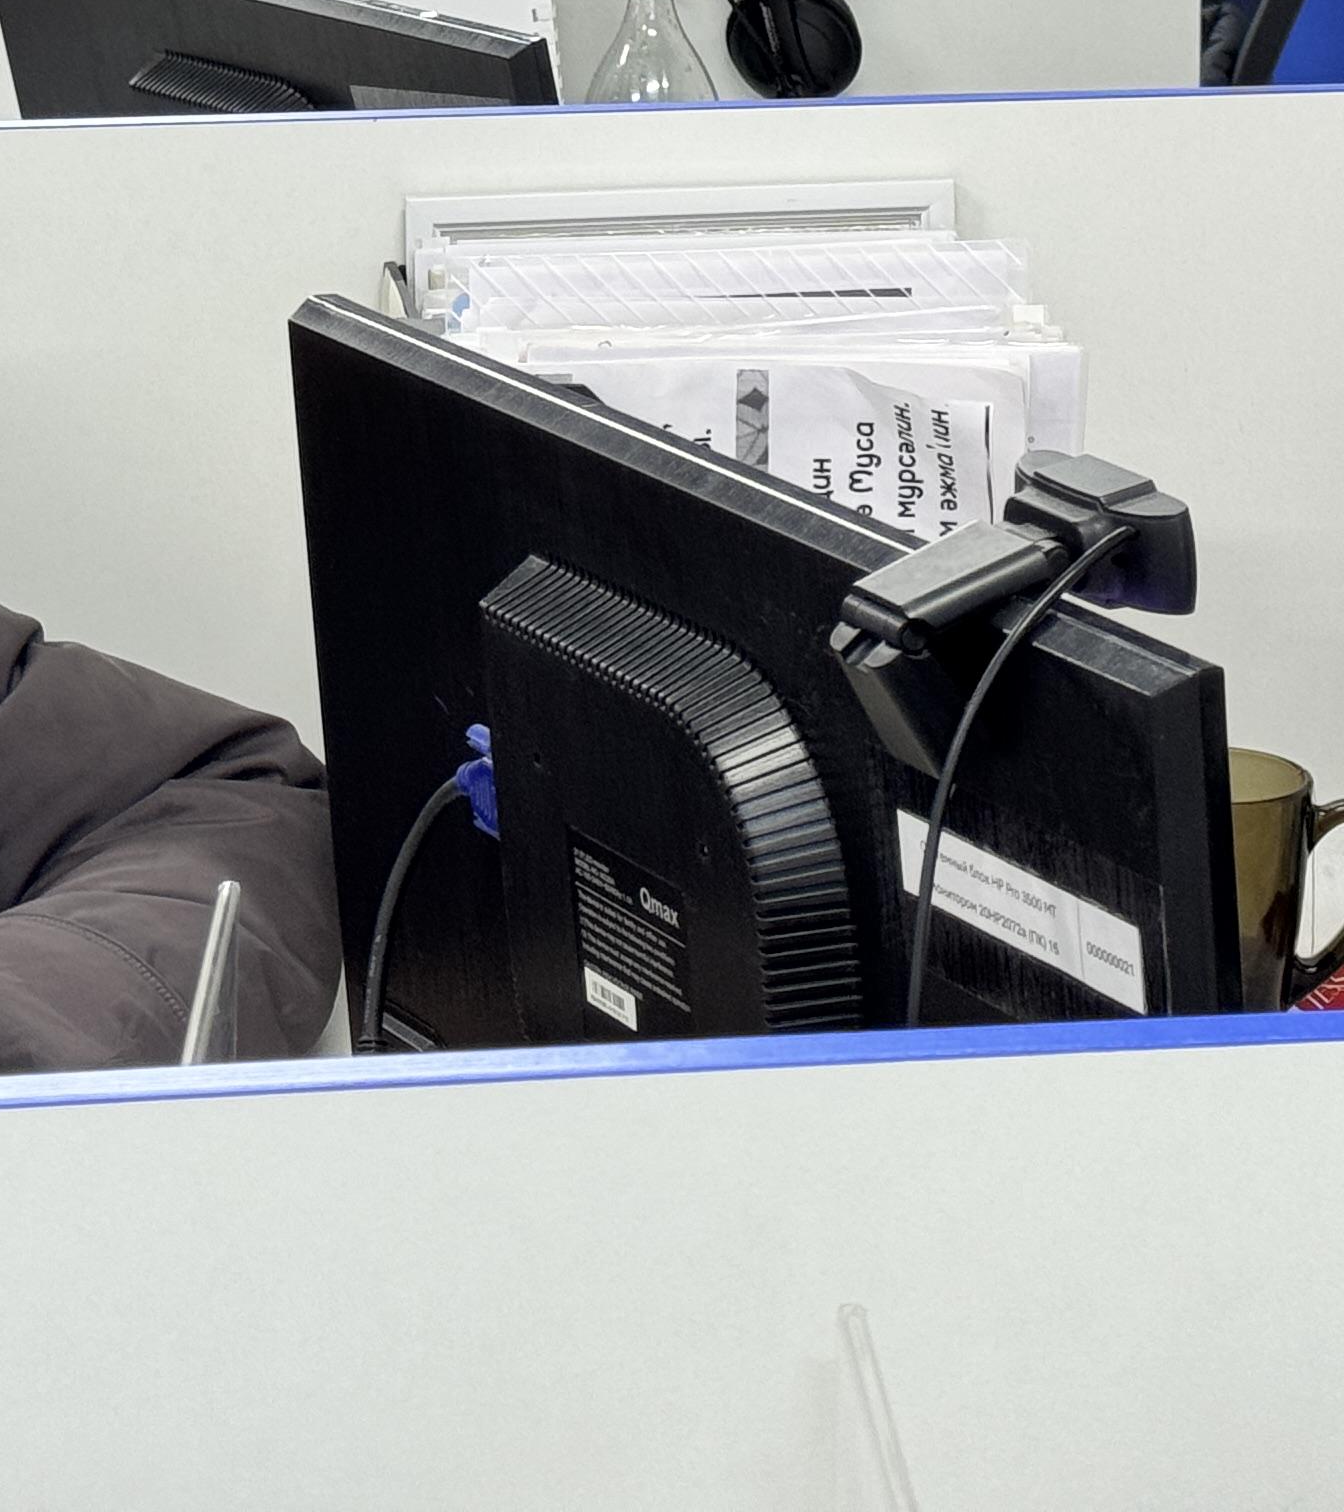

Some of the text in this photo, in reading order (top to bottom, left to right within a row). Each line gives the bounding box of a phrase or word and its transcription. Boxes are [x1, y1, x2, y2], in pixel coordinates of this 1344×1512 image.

[848, 422, 882, 493] Муса
[639, 886, 681, 929] Qmax
[933, 881, 978, 913] онитором
